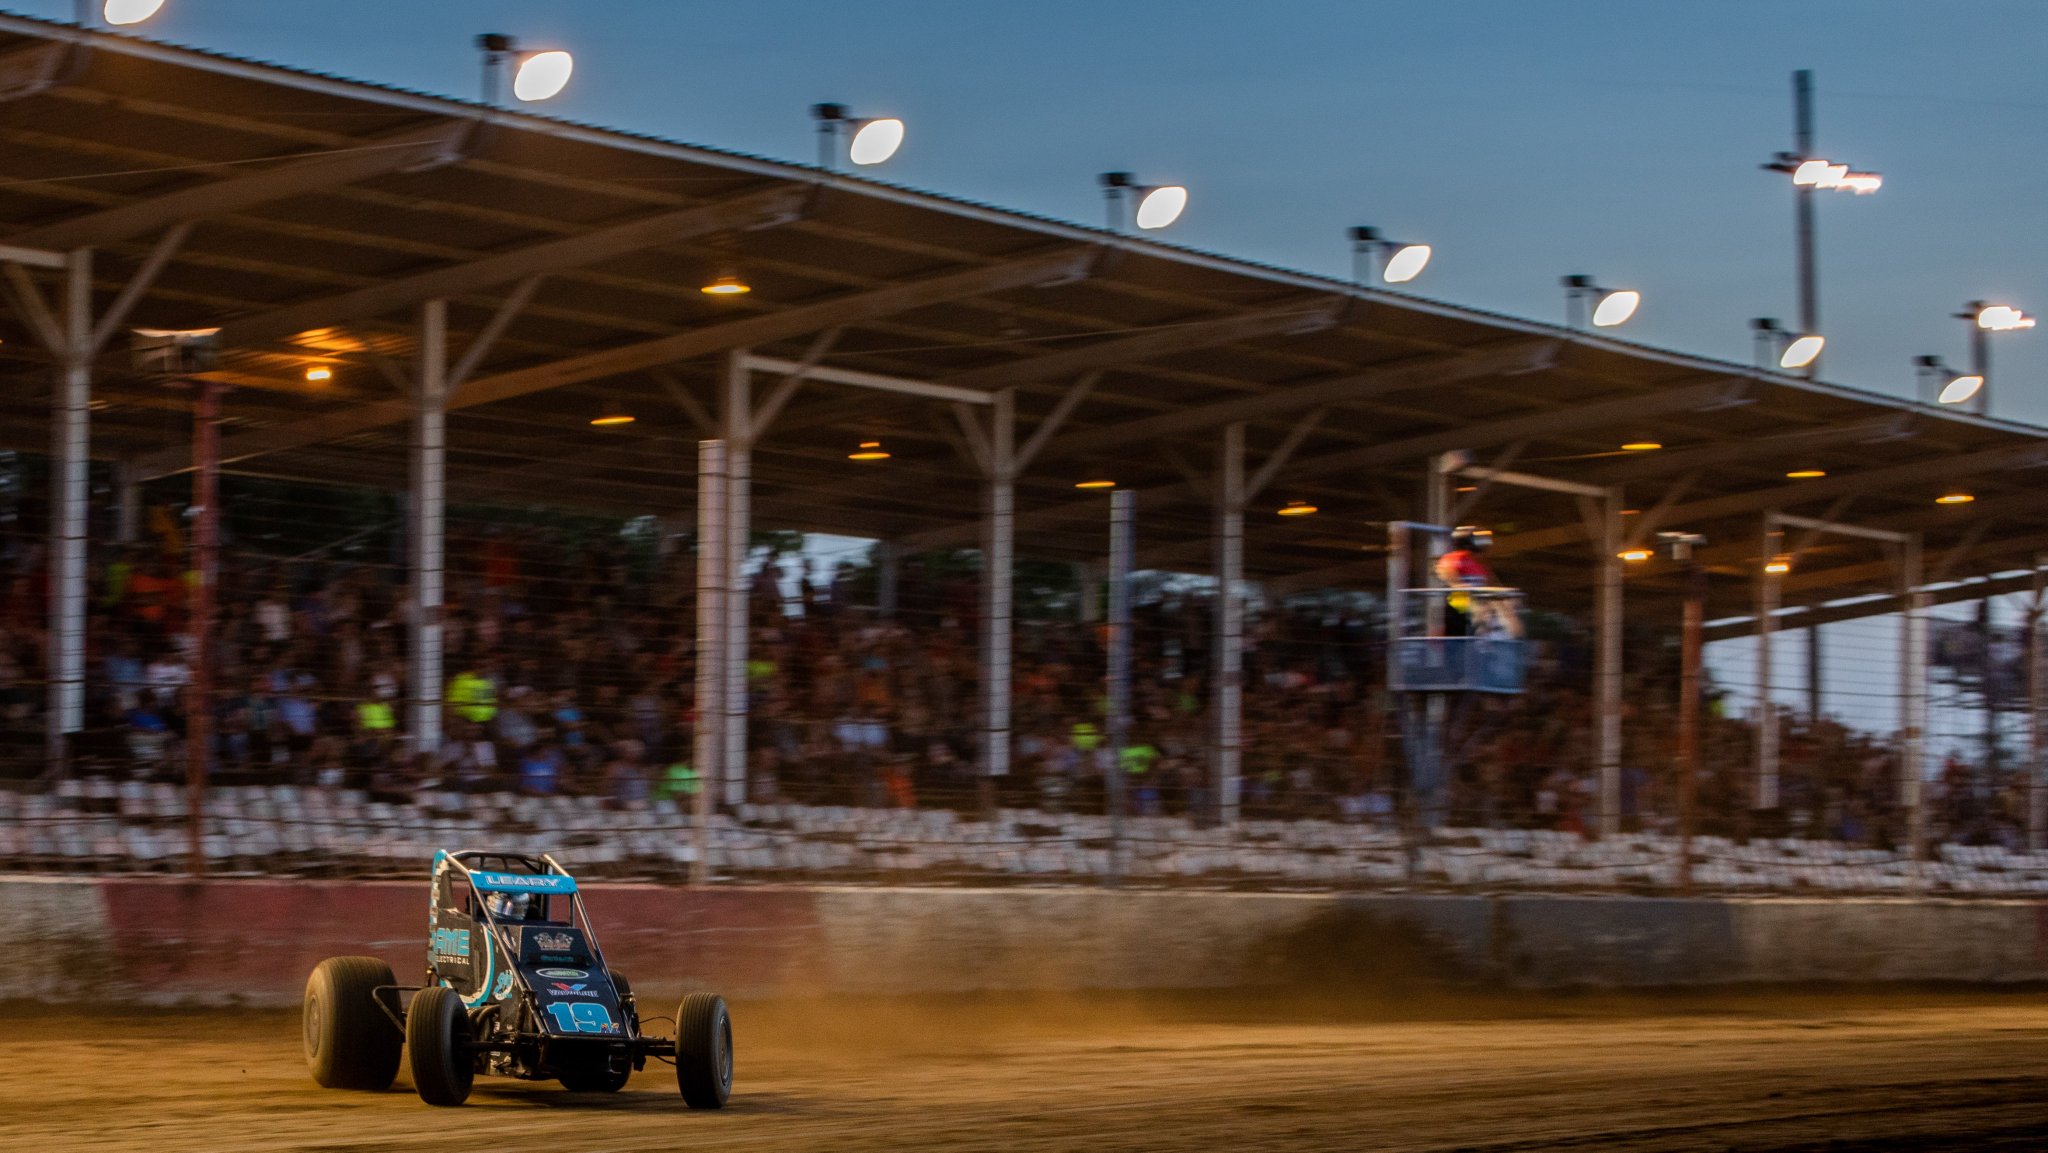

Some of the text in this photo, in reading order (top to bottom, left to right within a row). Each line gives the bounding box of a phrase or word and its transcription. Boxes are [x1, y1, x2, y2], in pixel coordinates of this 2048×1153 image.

[485, 875, 561, 887] LEARY
[437, 955, 470, 966] LECTRICAL
[546, 1001, 612, 1033] 19
